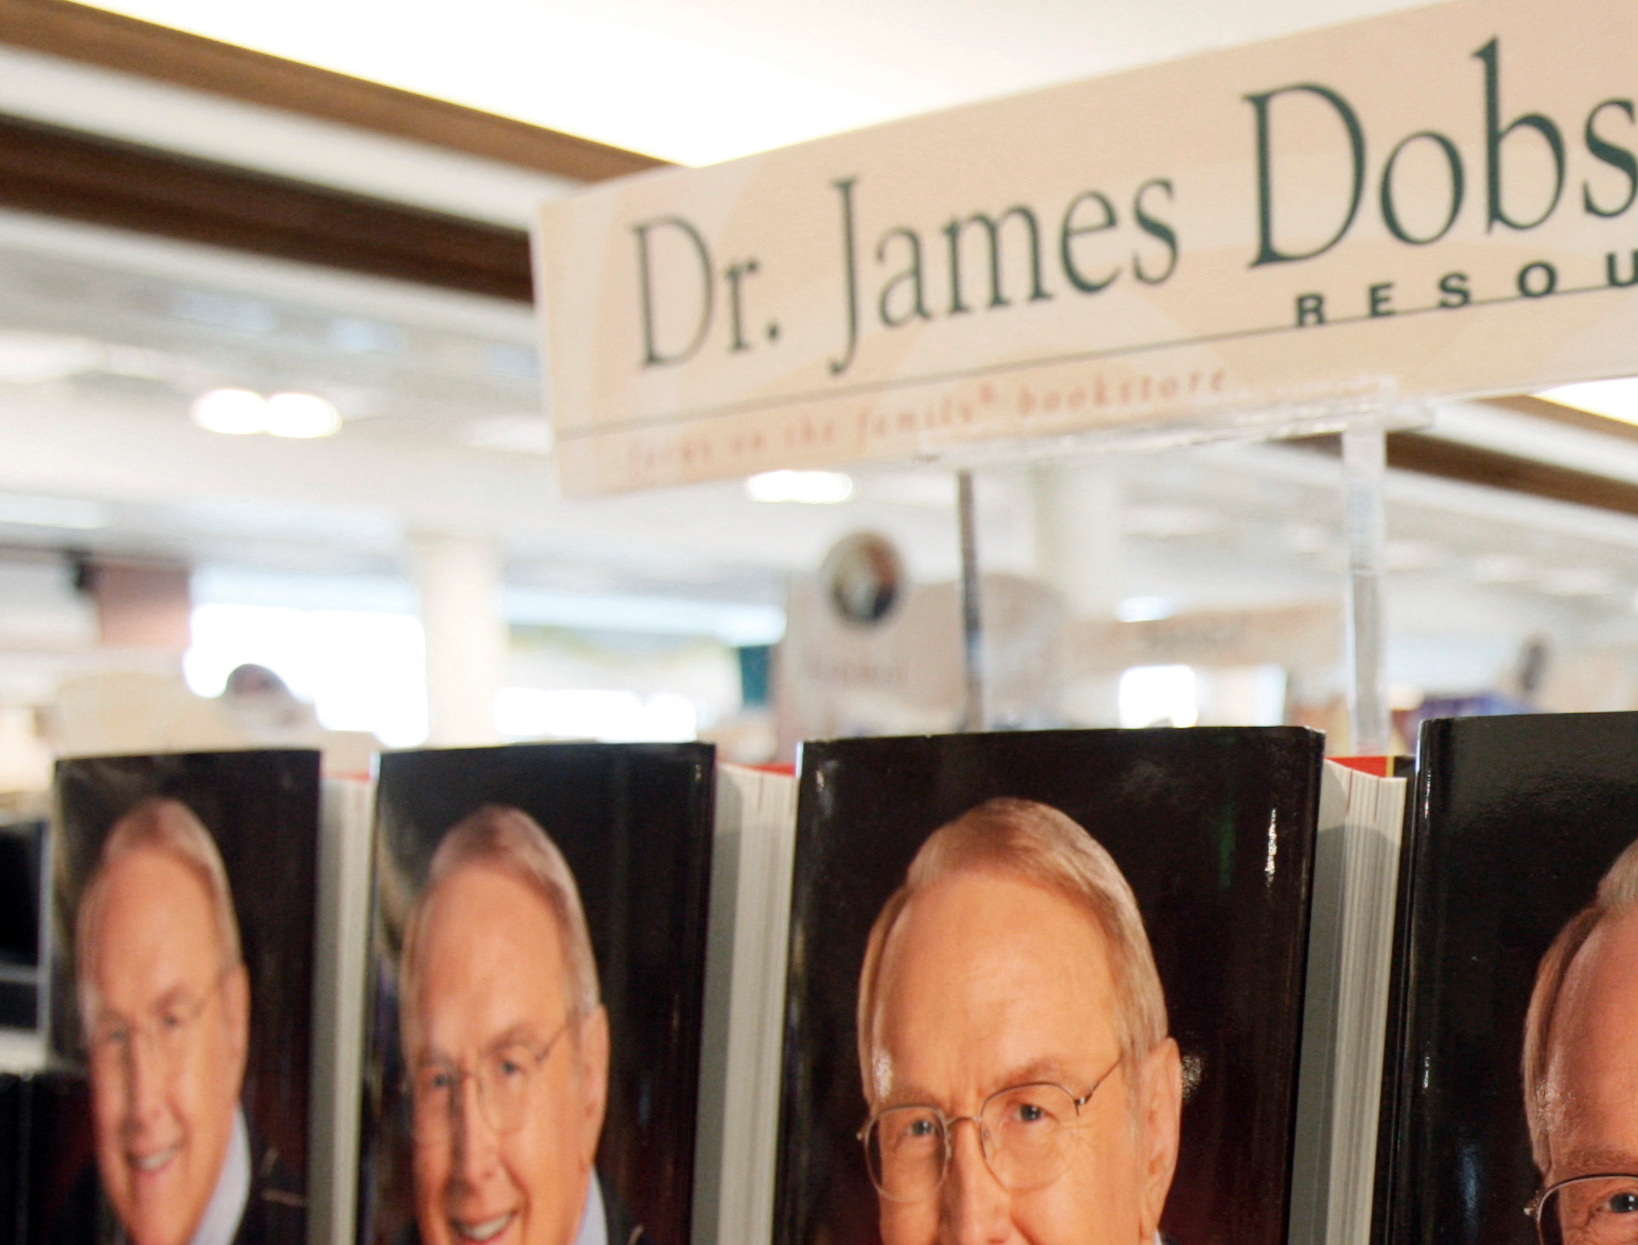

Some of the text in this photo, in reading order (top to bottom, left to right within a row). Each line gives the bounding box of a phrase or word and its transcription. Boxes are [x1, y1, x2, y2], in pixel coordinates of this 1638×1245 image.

[631, 214, 783, 371] Dr.
[829, 174, 1180, 377] James
[1016, 367, 1230, 418] bookstore
